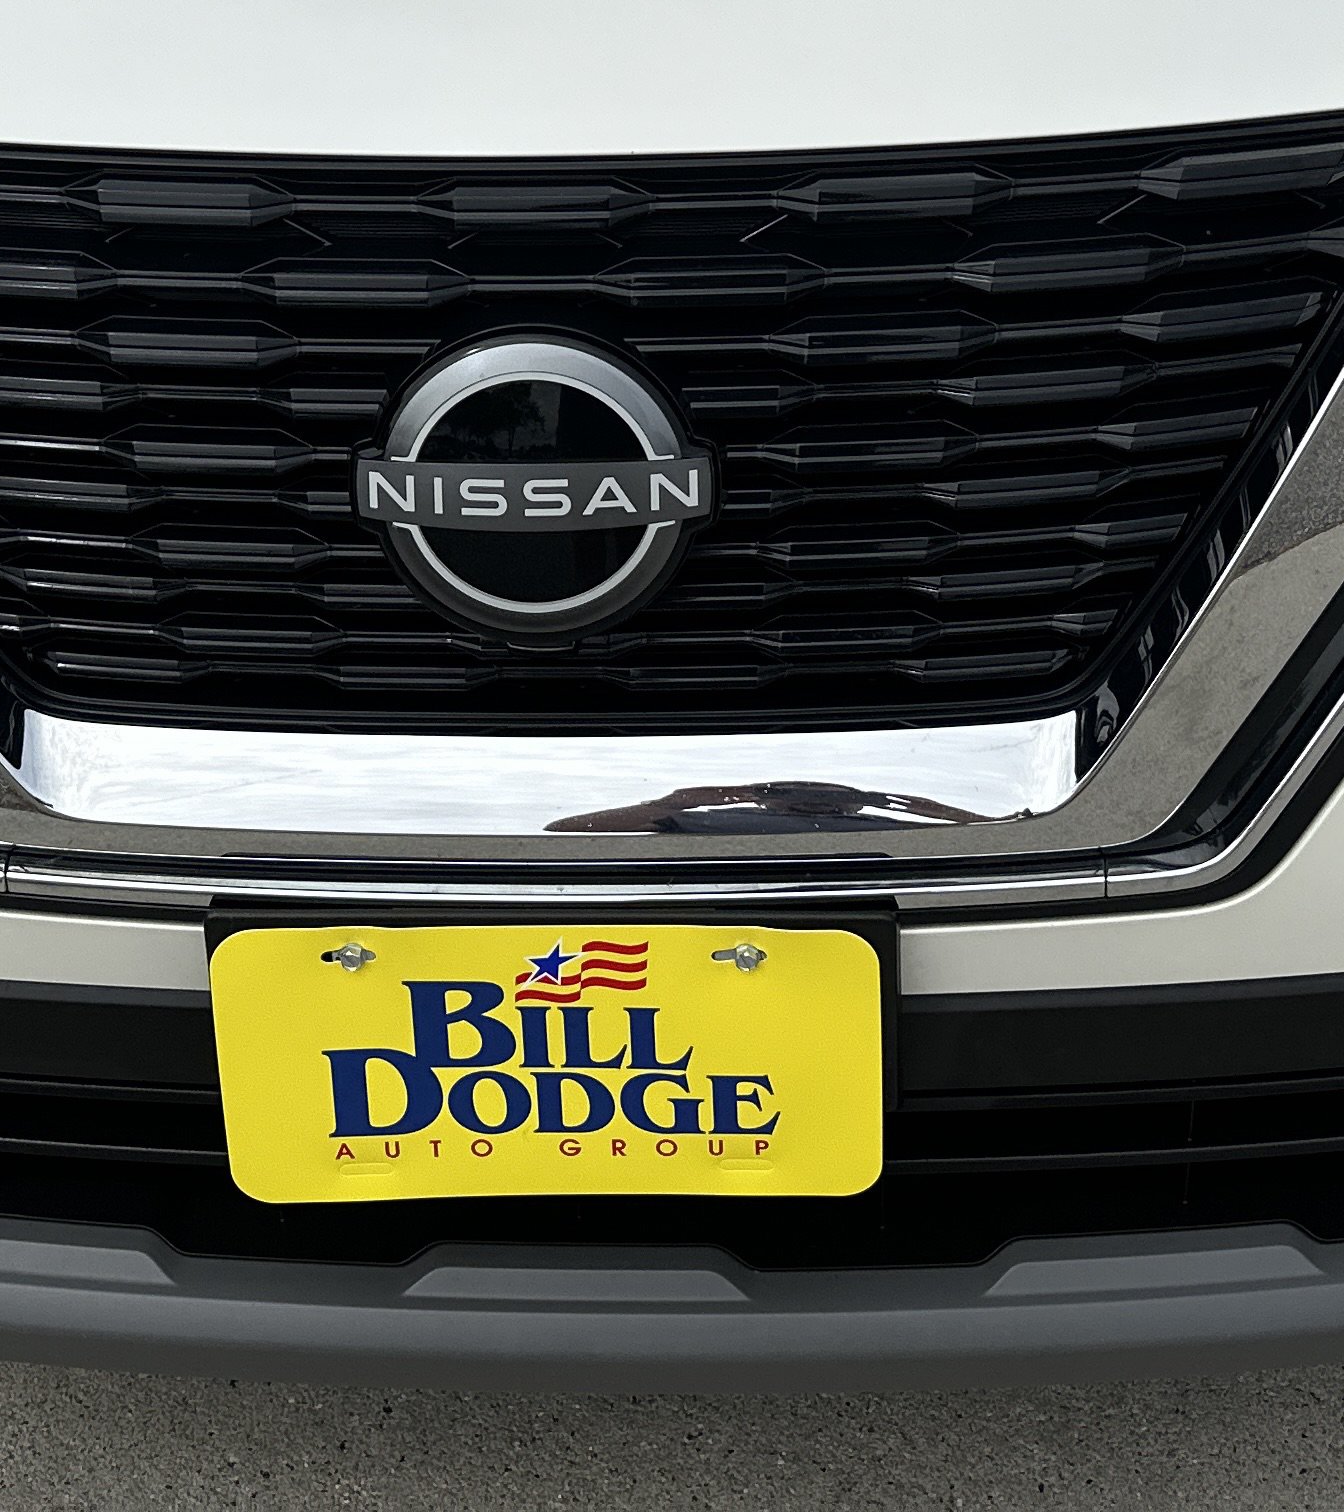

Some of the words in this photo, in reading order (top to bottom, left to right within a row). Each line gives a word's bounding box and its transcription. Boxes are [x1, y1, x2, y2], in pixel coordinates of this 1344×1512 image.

[368, 469, 699, 517] NISSAN
[401, 980, 694, 1071] BILL
[321, 1048, 781, 1138] DODGE
[335, 1138, 494, 1161] AUTO
[559, 1138, 770, 1159] GROUP
